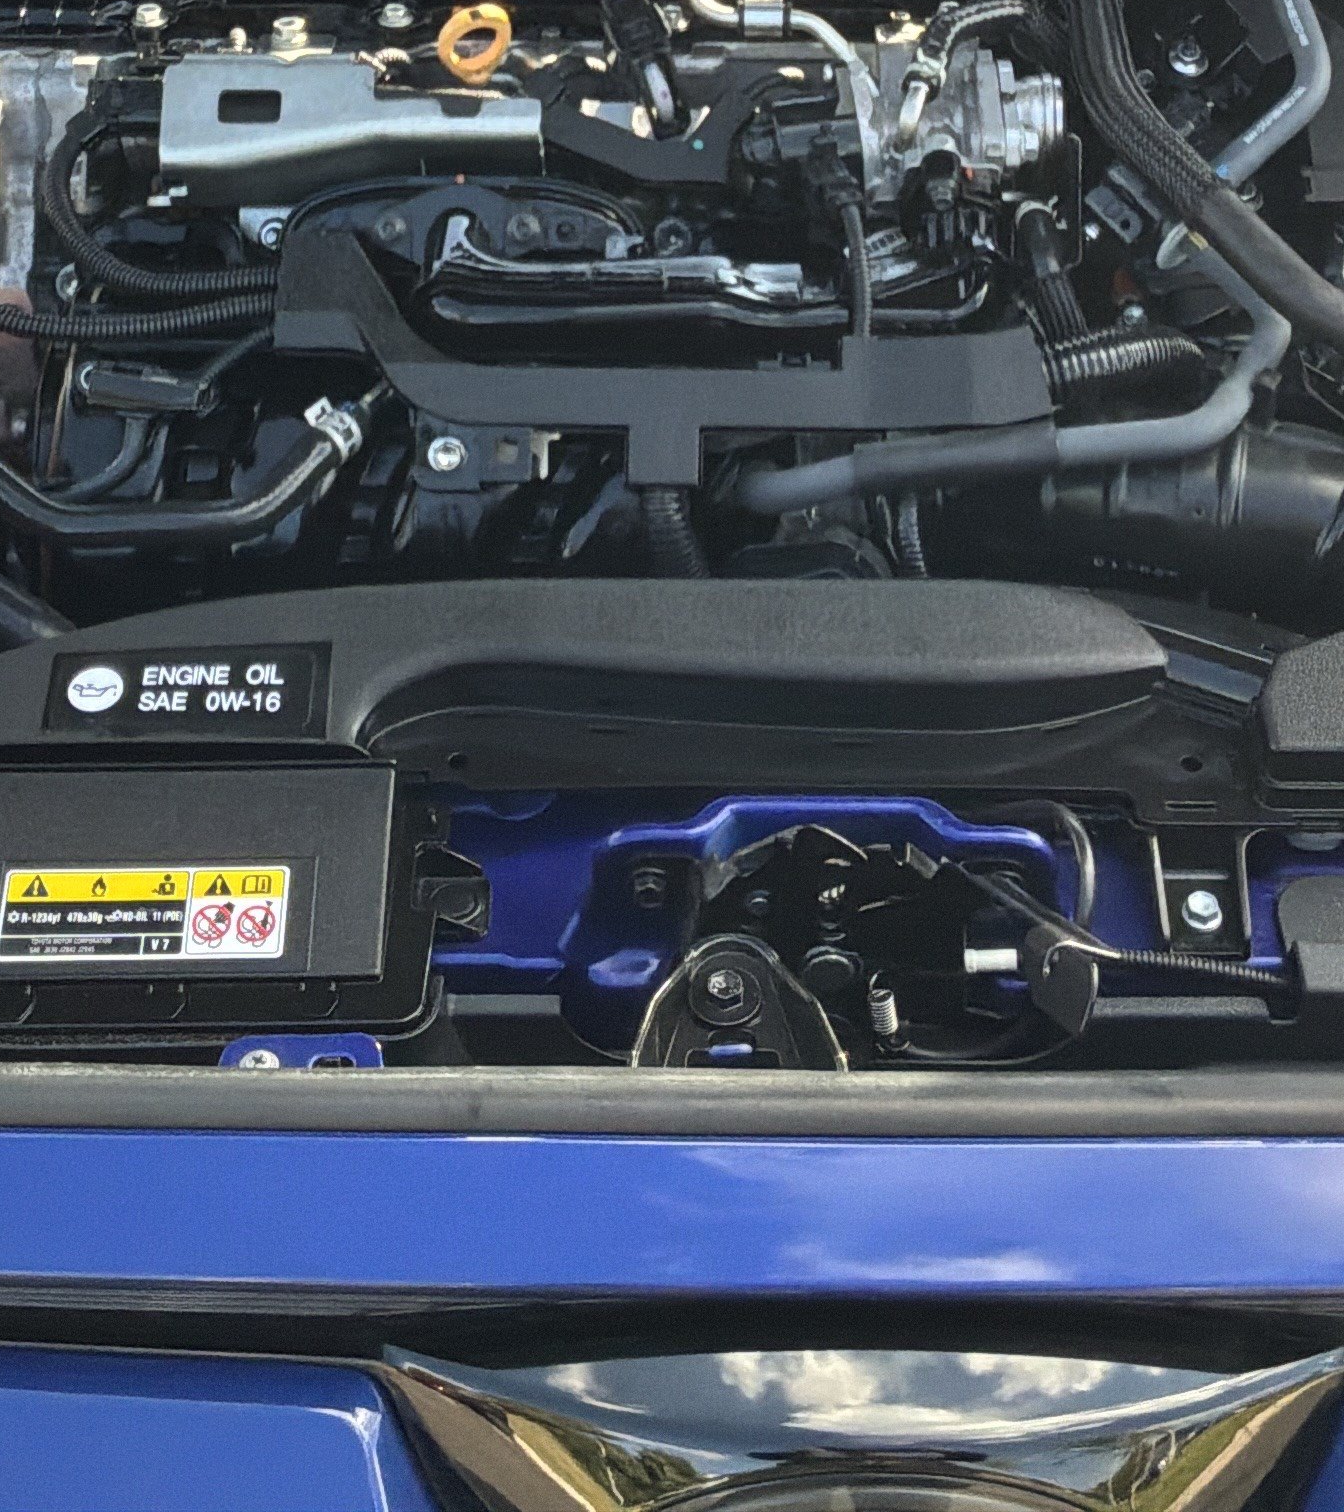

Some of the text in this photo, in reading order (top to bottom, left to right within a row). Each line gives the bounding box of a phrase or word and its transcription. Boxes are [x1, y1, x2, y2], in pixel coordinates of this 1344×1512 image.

[142, 663, 285, 686] ENGINE OIL
[137, 690, 282, 713] SAE 0W-16
[151, 938, 170, 951] V 7
